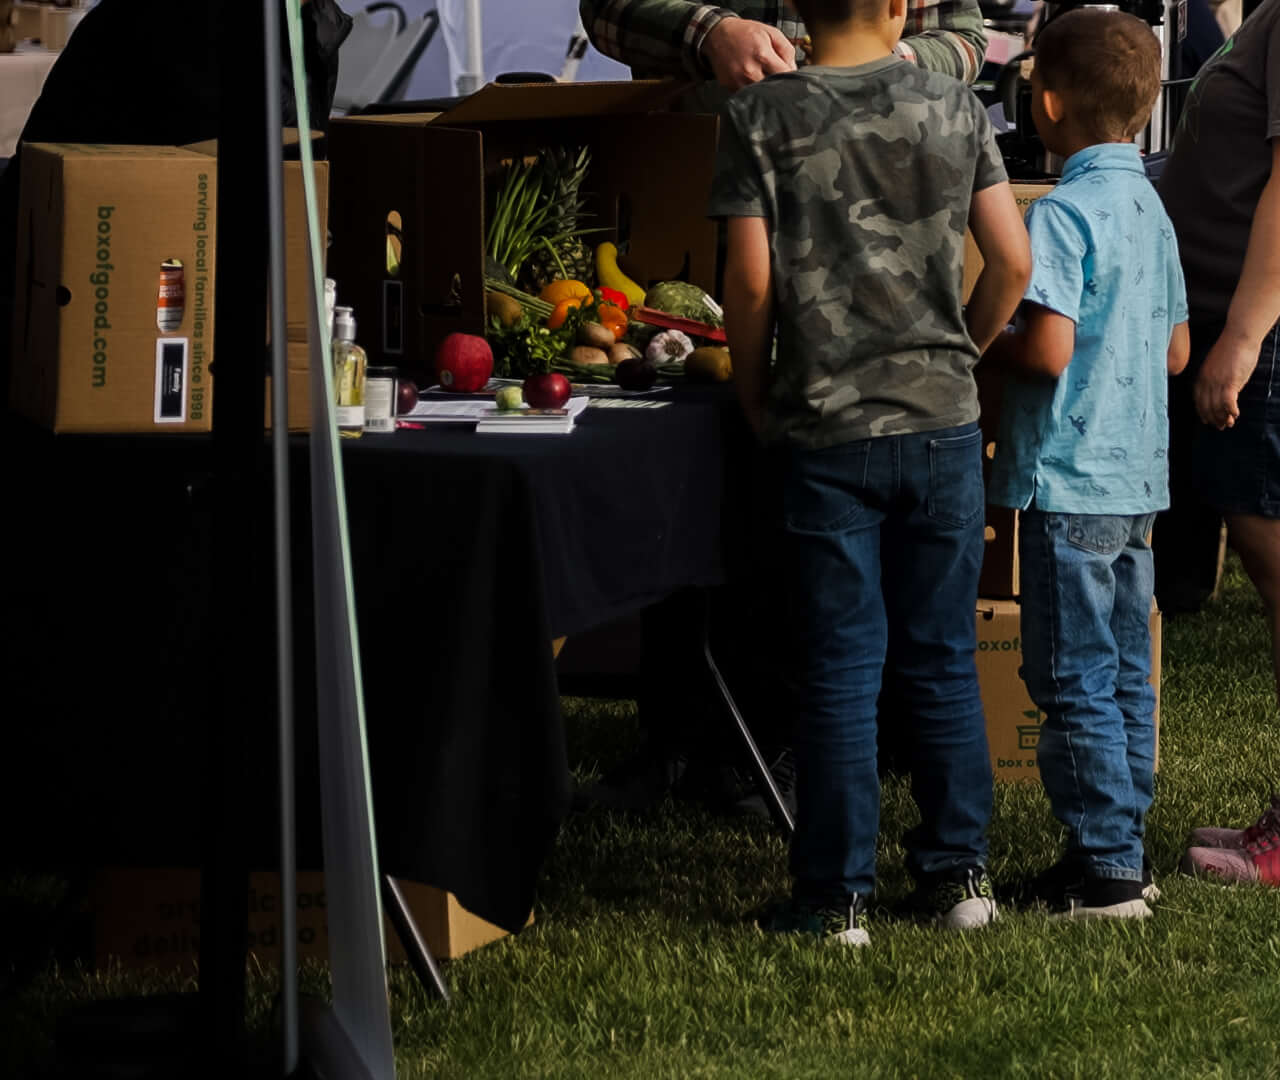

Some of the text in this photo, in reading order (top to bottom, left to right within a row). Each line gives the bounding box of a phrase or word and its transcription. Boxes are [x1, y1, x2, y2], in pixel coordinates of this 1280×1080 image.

[193, 174, 210, 232] serving
[195, 235, 208, 273] local
[89, 205, 116, 388] boxofgood.com
[193, 276, 208, 338] families
[192, 343, 206, 384] since
[997, 756, 1022, 768] box
